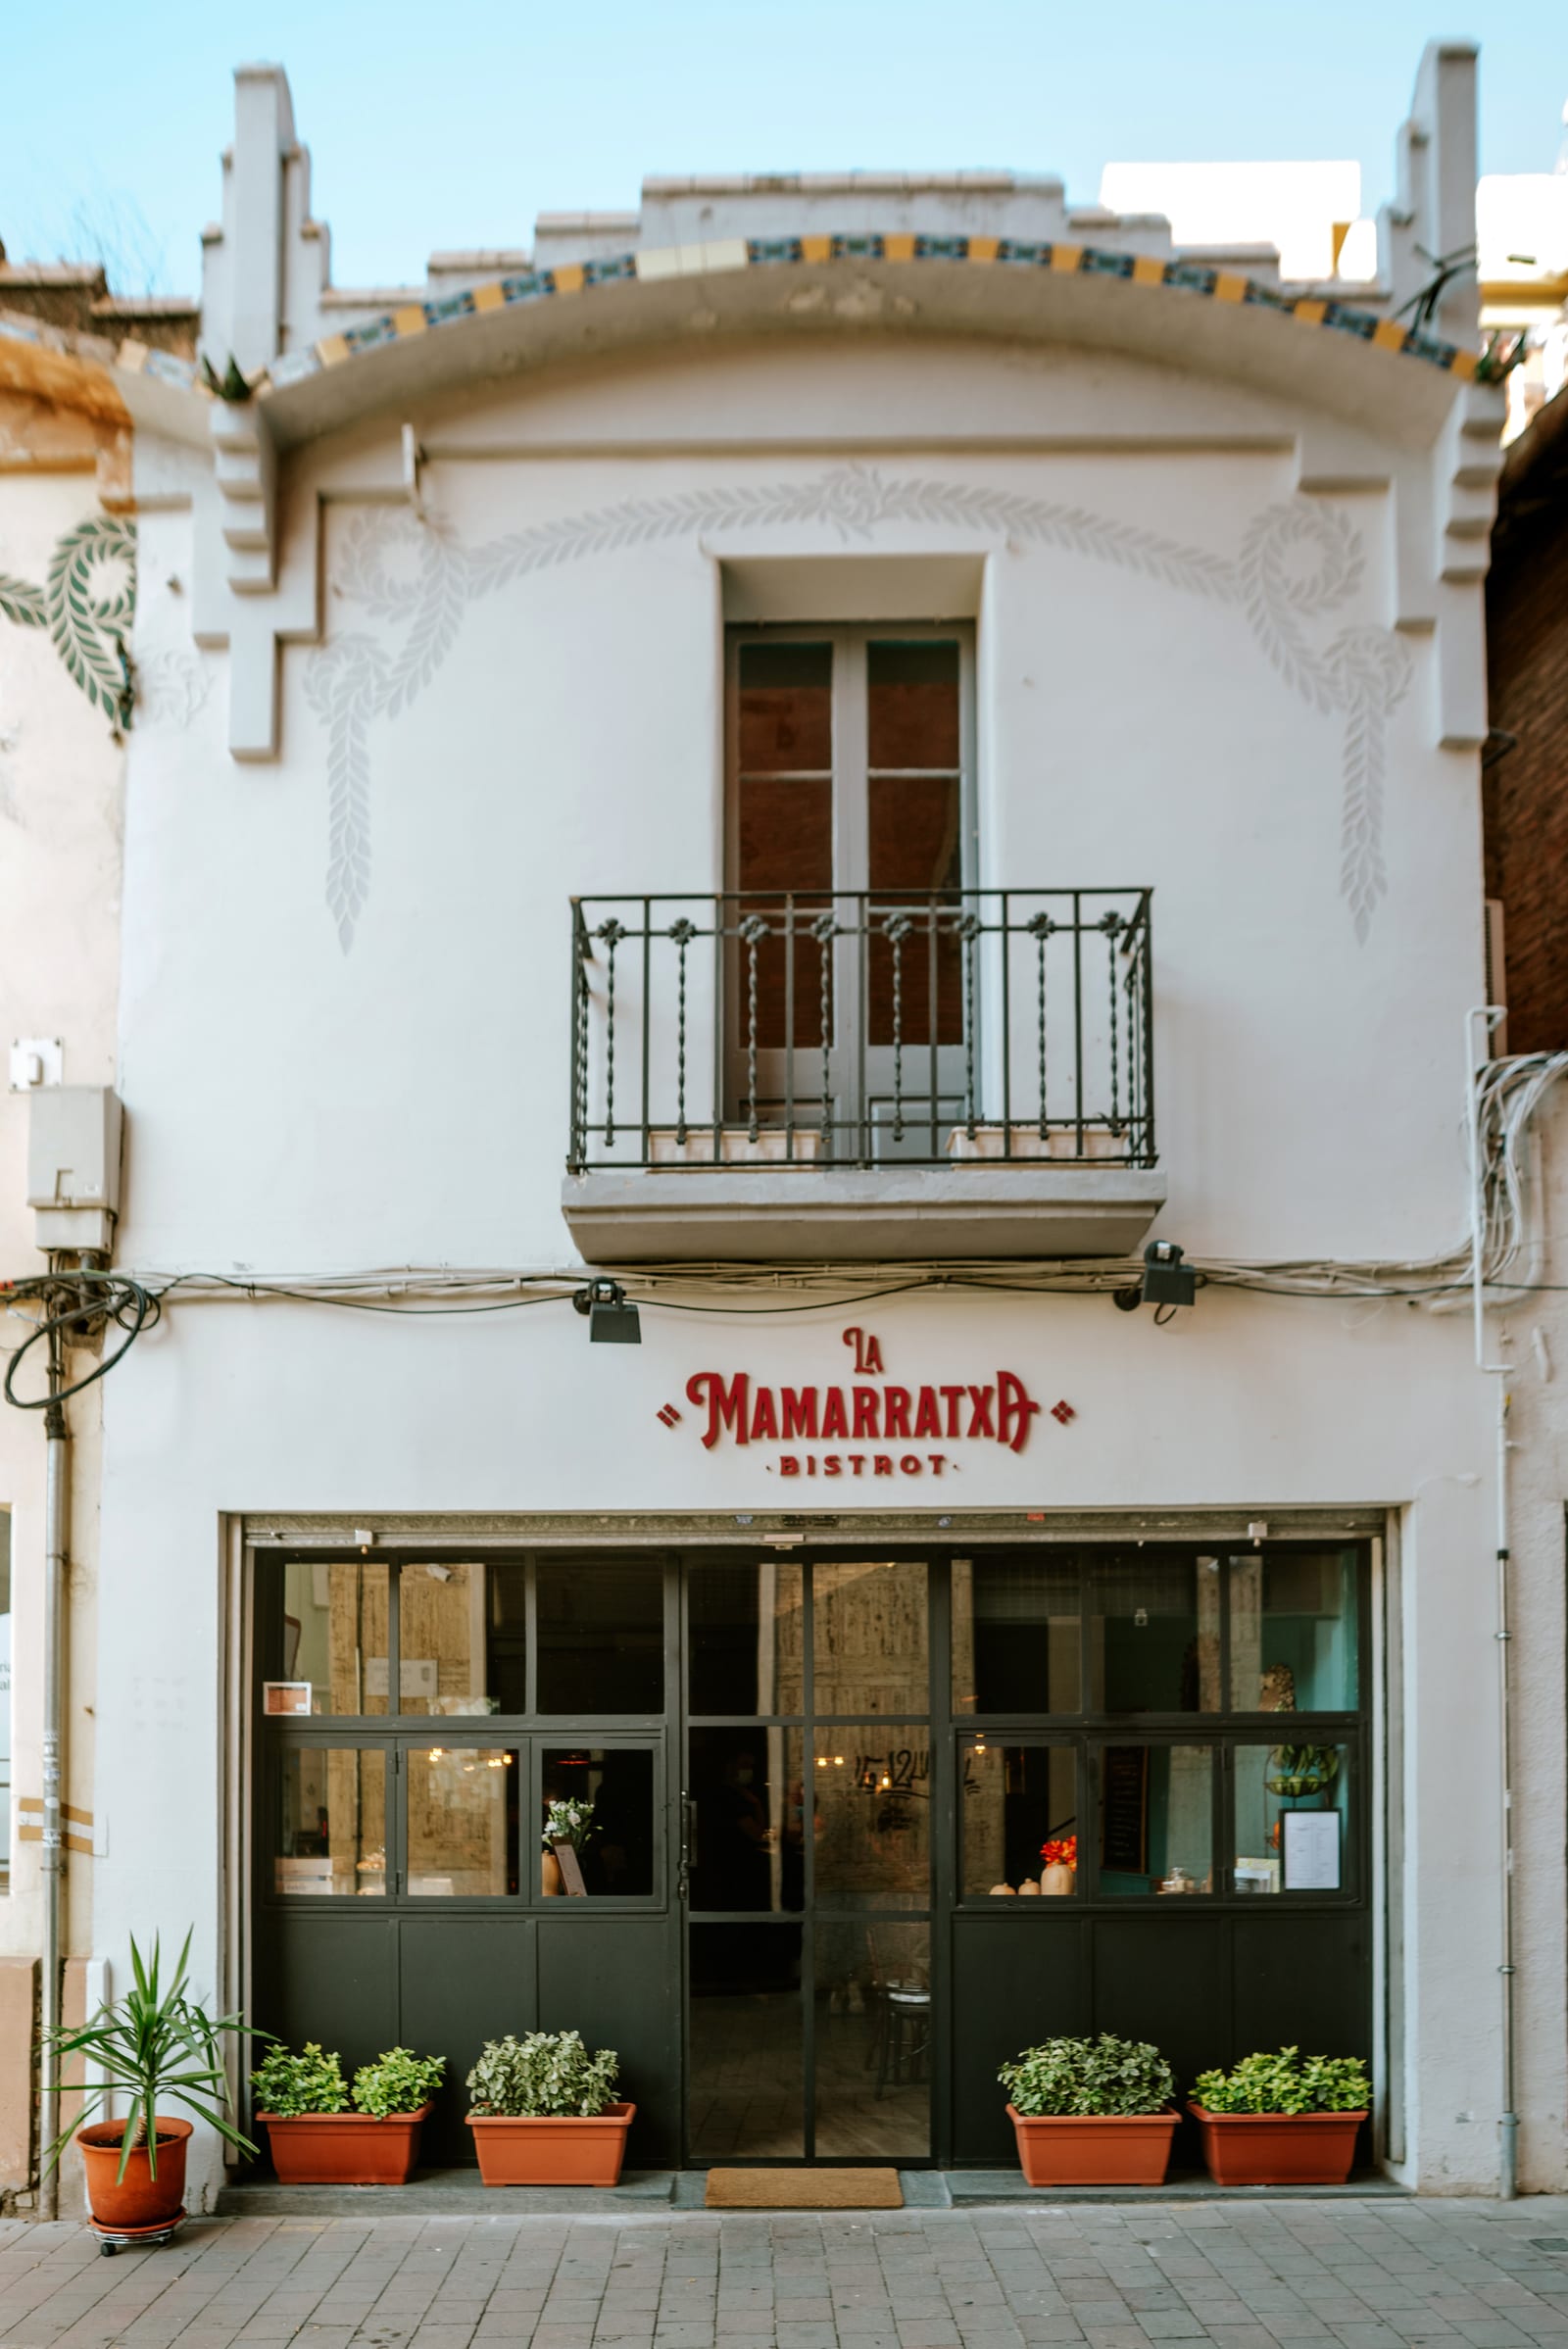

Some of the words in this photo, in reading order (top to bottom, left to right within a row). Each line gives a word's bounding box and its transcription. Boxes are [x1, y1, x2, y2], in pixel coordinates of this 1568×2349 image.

[843, 1327, 884, 1375] LA
[686, 1371, 1039, 1452] MAMARRATXA
[779, 1454, 946, 1476] BISTROT
